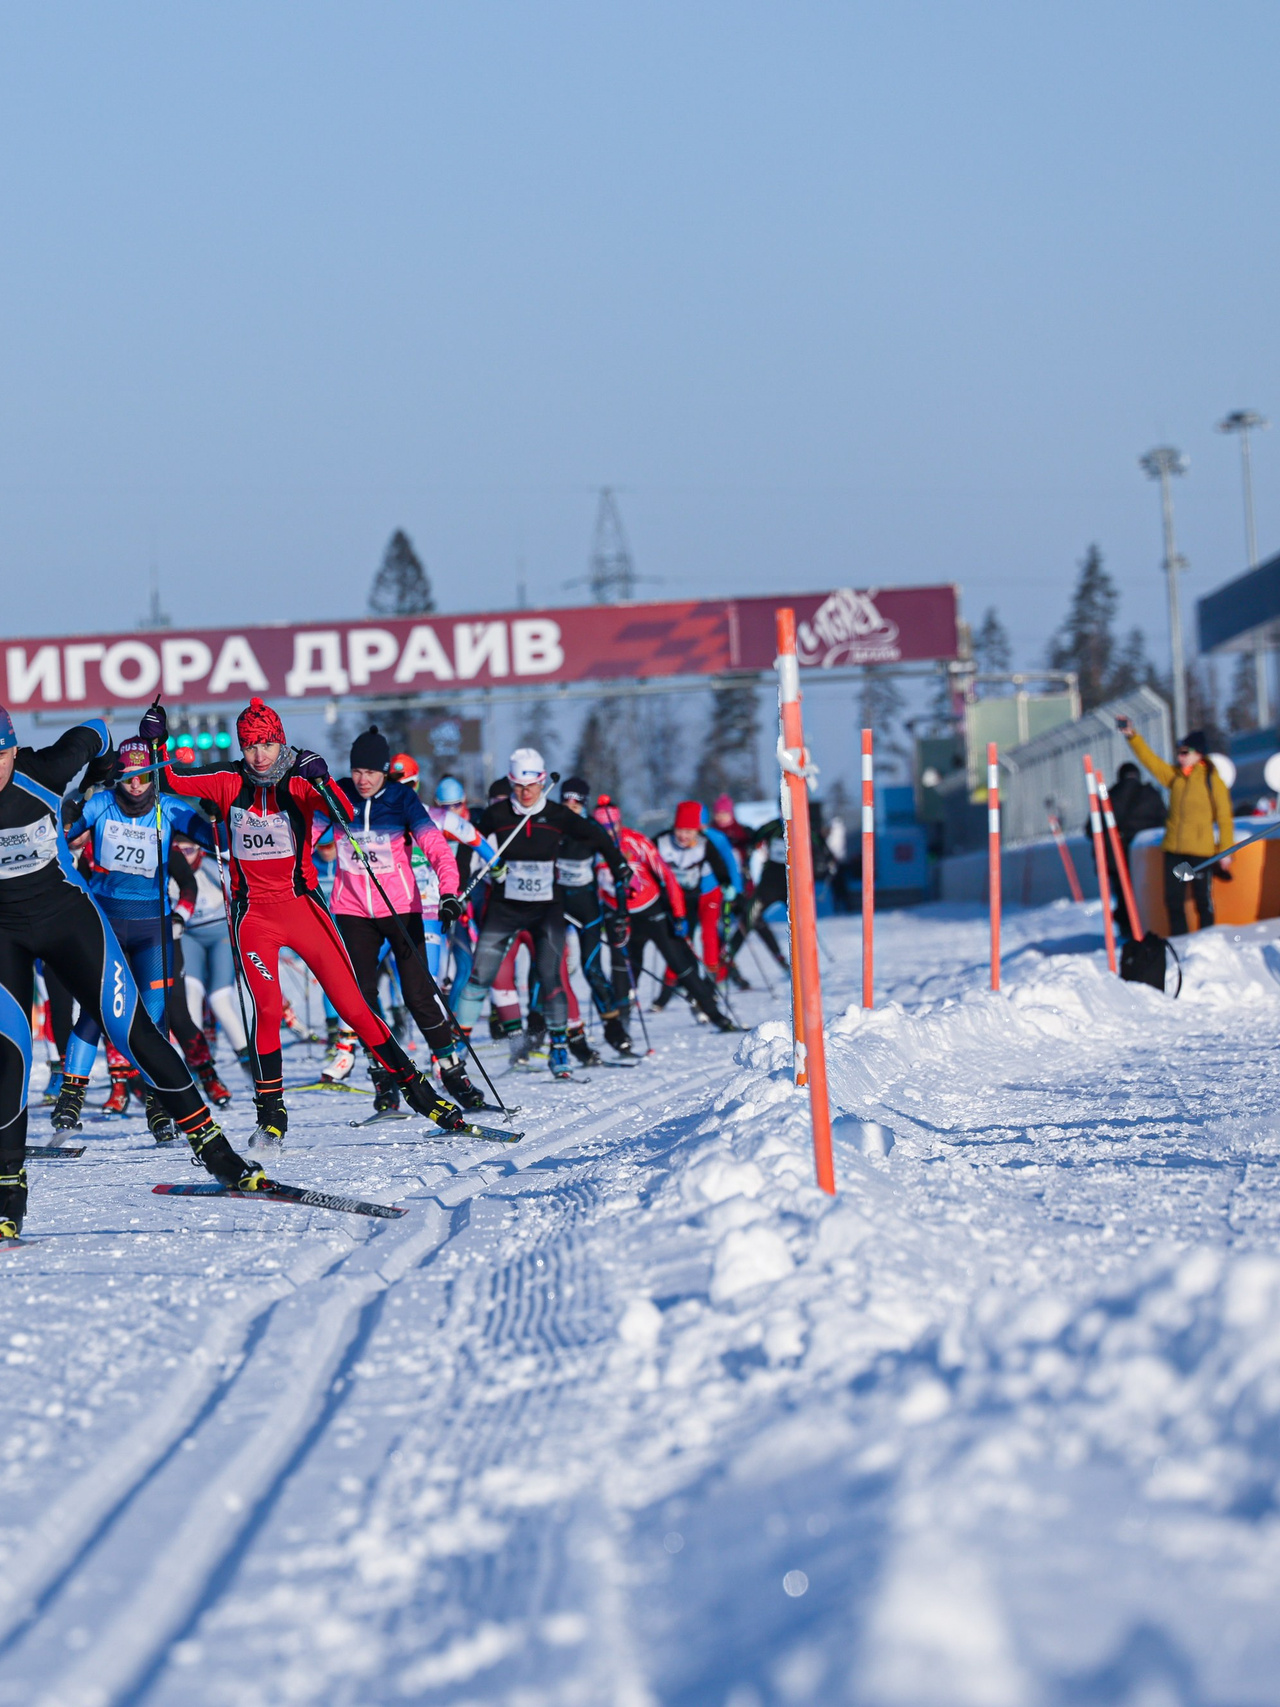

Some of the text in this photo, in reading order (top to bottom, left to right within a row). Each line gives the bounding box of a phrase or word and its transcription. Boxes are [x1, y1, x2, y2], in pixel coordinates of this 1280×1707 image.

[6, 619, 565, 703] ИГОРА ДРАЙВ
[242, 834, 275, 849] 504
[114, 844, 145, 864] 279
[517, 878, 542, 892] 285
